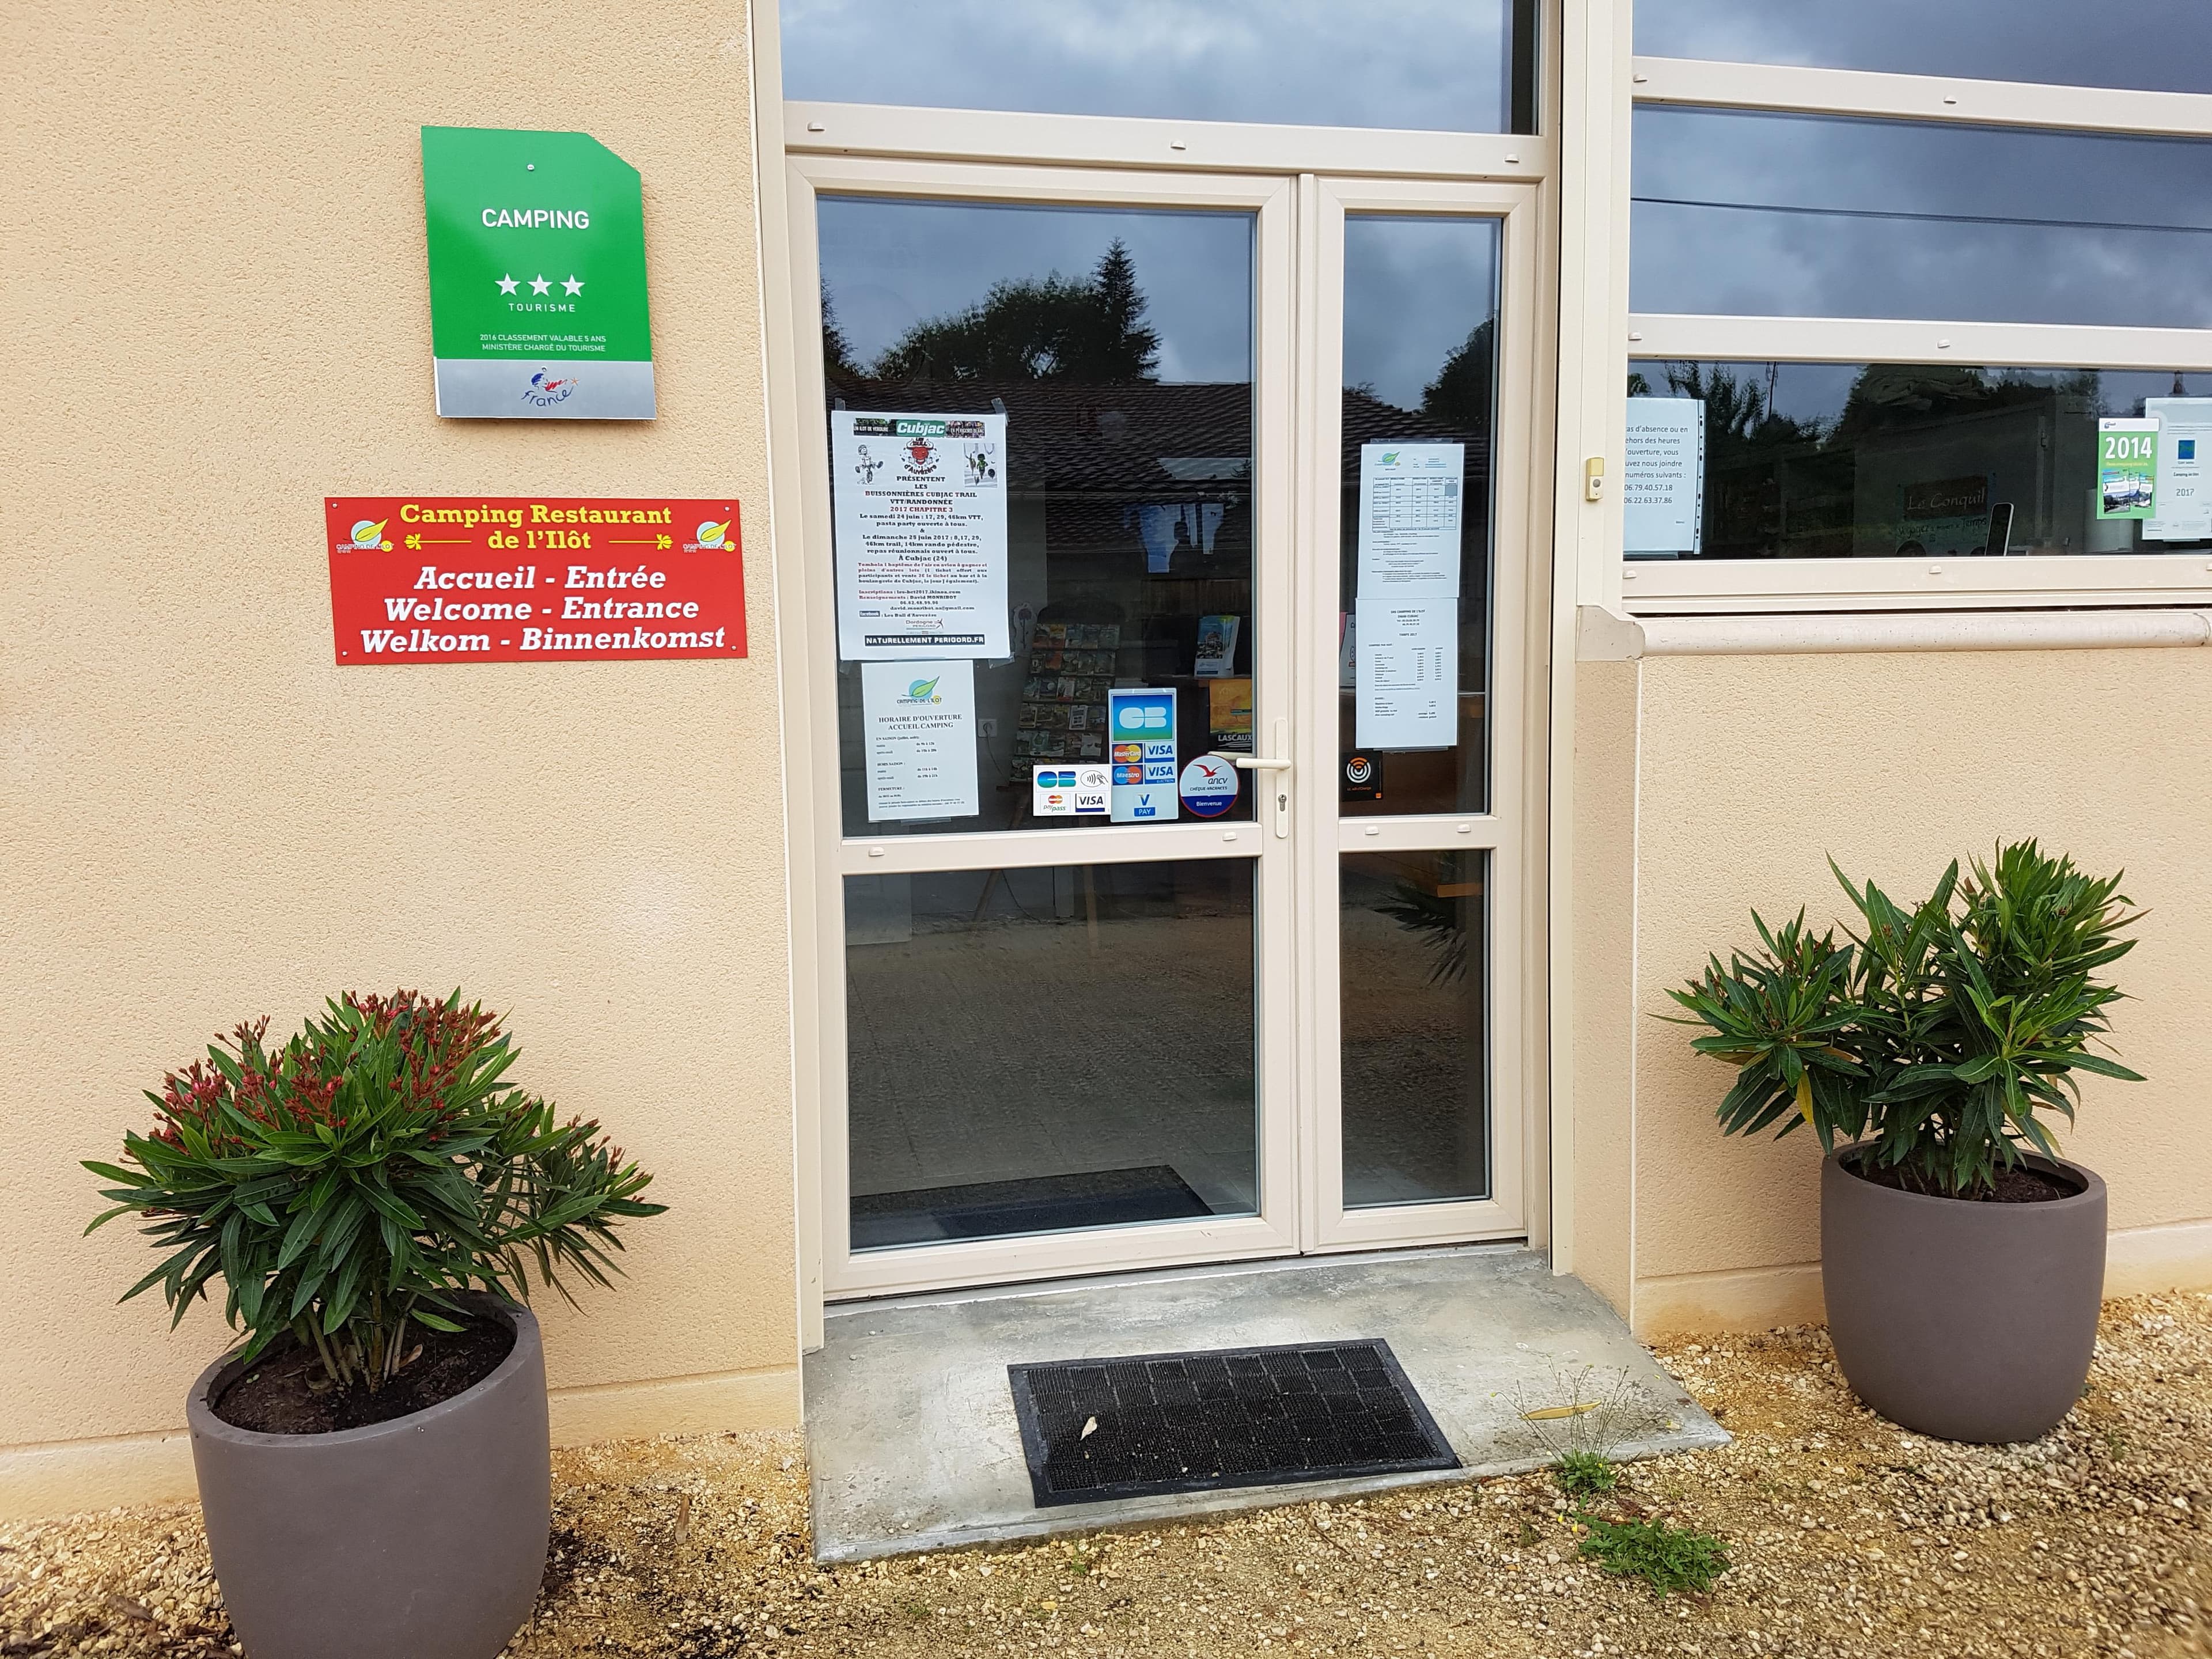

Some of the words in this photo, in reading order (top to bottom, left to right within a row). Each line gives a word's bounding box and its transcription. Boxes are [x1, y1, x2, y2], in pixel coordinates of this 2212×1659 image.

[482, 209, 589, 229] CAMPING
[509, 303, 575, 312] TOURISME
[482, 342, 522, 351] MINISTÈRE
[524, 343, 554, 351] CHARGÉ
[897, 422, 945, 436] Cubjac
[2105, 437, 2153, 459] 2014
[400, 504, 522, 528] Camping
[531, 505, 672, 524] Restaurant
[488, 531, 520, 550] de
[414, 566, 535, 590] Accueil
[565, 566, 666, 589] Entrée
[384, 598, 532, 622] Welcome
[561, 597, 699, 620] Entrance
[361, 630, 490, 653] Welkom
[520, 626, 725, 651] Binnenkomst
[1218, 733, 1252, 742] LASCAUX
[1148, 745, 1173, 755] VISA
[1147, 766, 1173, 776] VISA
[1078, 796, 1103, 805] VISA
[1138, 794, 1150, 806] V
